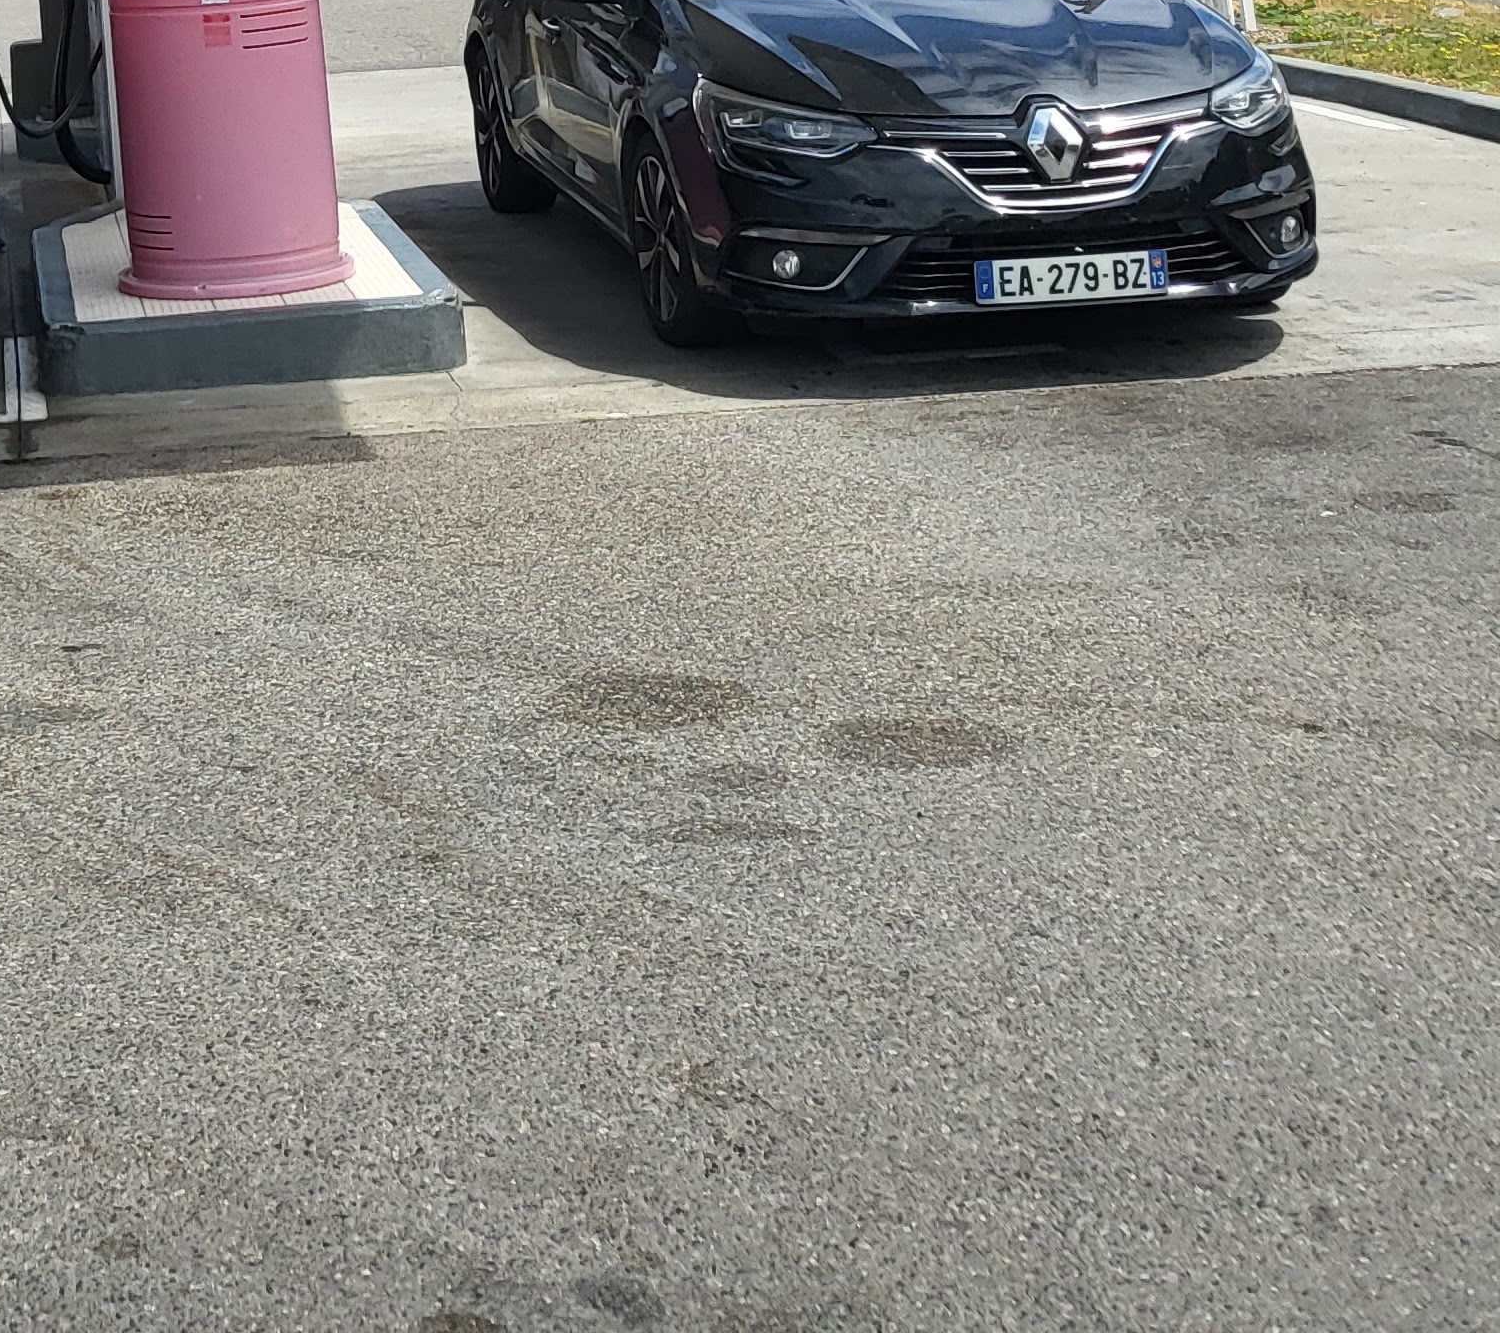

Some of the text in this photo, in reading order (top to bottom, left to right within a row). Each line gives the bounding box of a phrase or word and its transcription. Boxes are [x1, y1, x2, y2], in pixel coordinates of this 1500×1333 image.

[999, 258, 1148, 297] EA-279-BZ
[1151, 271, 1165, 287] 13
[981, 283, 989, 294] F
